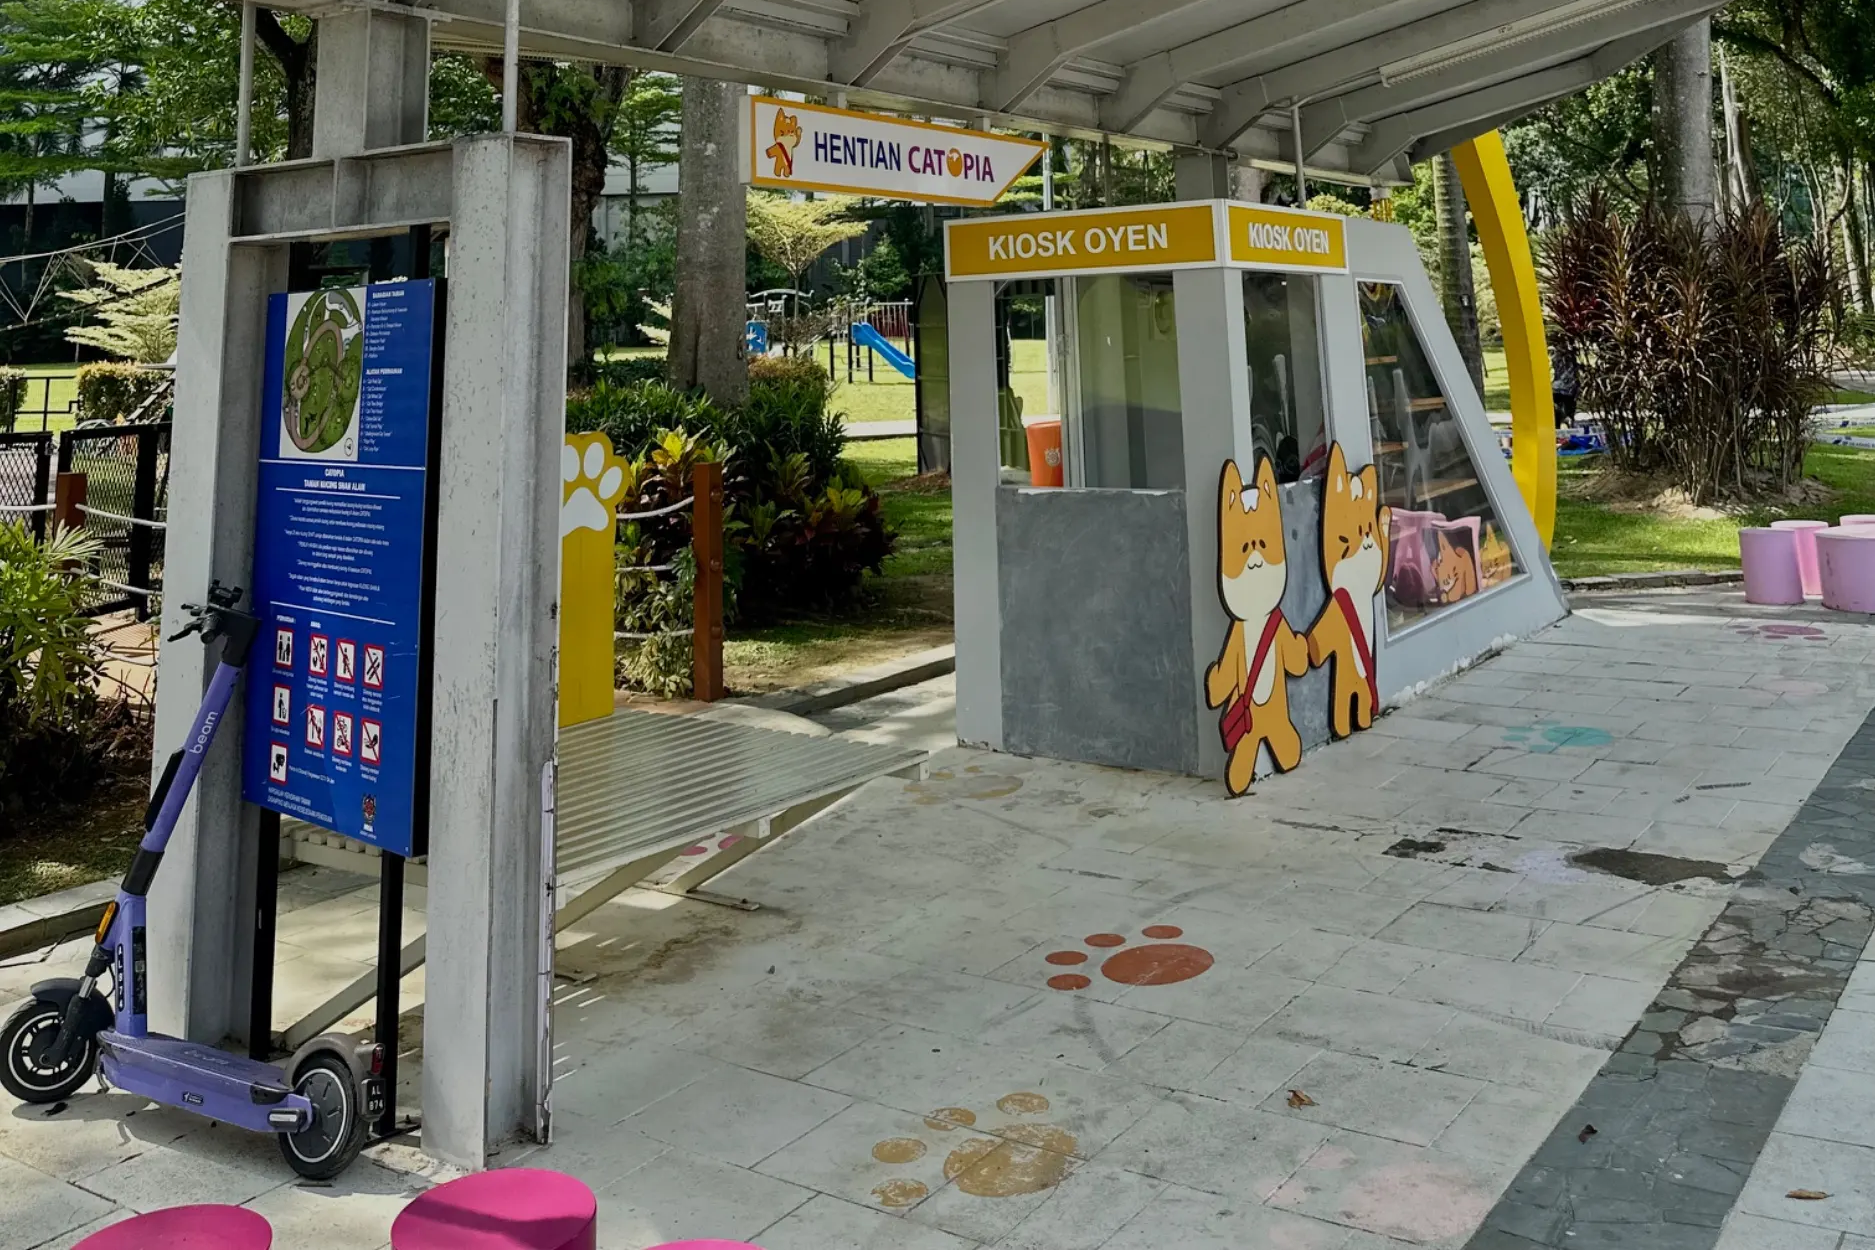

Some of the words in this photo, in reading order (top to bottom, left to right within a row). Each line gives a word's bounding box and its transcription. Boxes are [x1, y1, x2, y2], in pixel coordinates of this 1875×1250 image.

[814, 131, 901, 172] HENTIAN
[908, 145, 995, 183] CATOPIA
[988, 229, 1077, 261] KIOSK
[1083, 223, 1168, 253] OYEN
[1248, 221, 1291, 252] KIOSK
[1293, 226, 1330, 255] OYEN
[189, 711, 219, 754] beam
